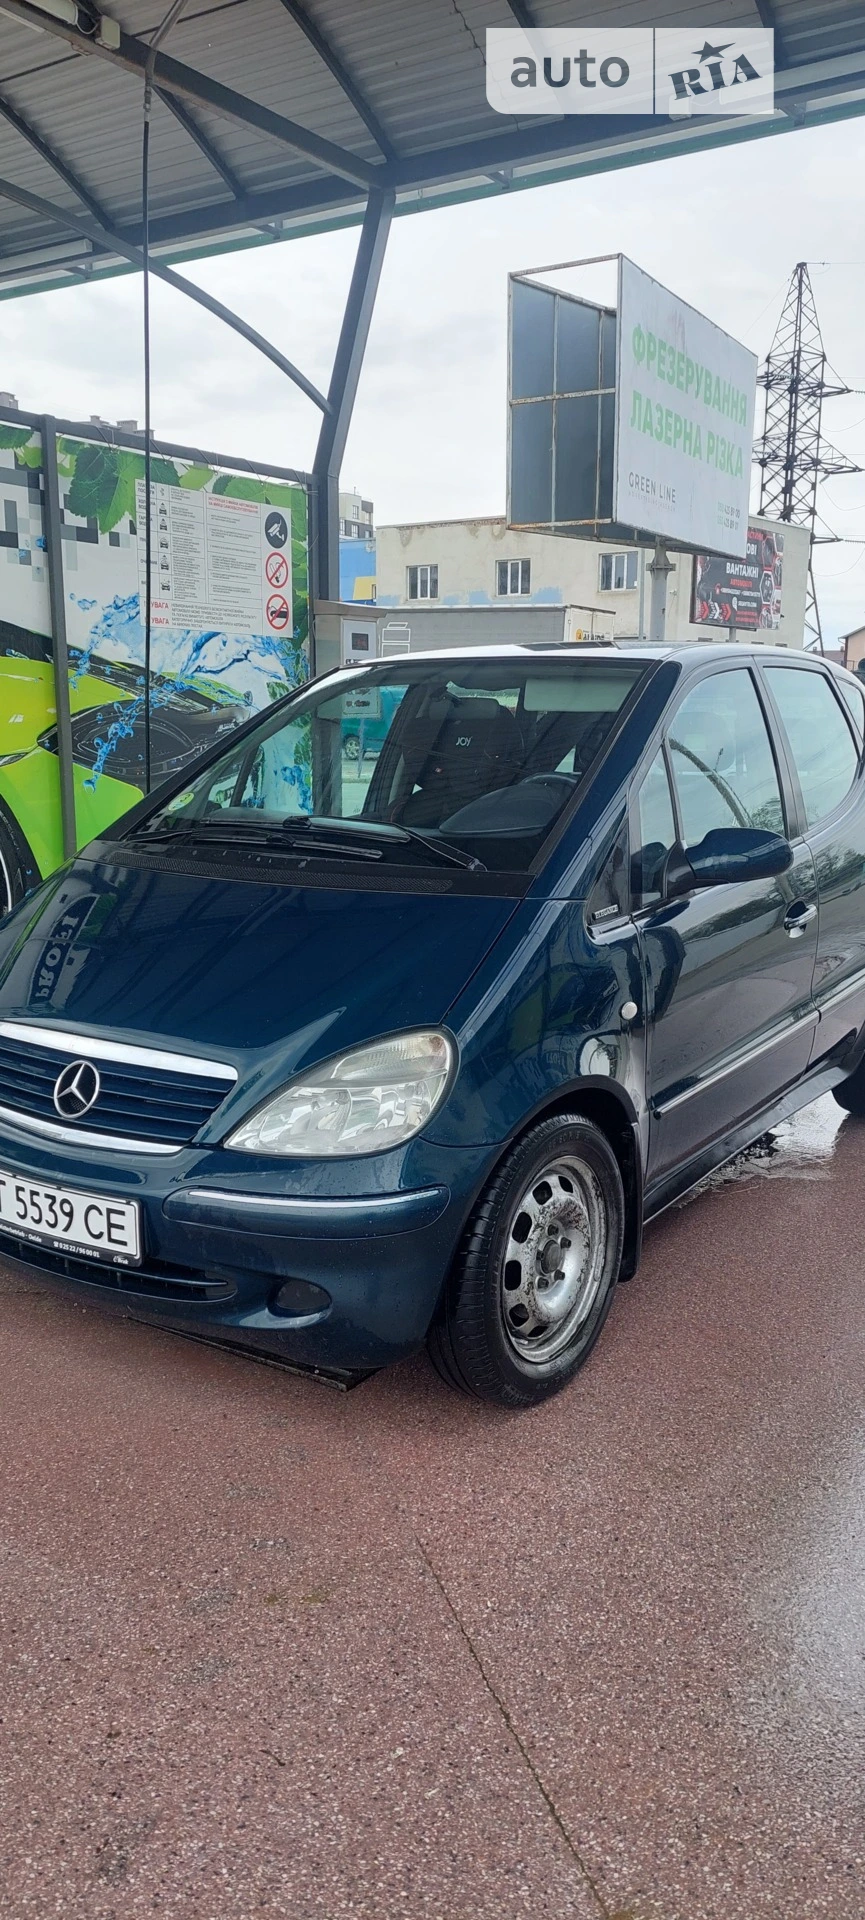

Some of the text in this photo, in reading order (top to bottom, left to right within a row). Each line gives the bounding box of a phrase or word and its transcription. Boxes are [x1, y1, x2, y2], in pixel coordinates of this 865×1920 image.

[632, 323, 747, 427] ФРЕЗЕРУВАННЯ
[630, 389, 744, 479] ЛАЗЕРНА РІЗКА
[629, 471, 676, 504] GREEN LINE
[726, 562, 759, 578] ВАНТАЖНІ
[150, 601, 169, 609] УВАГА
[151, 617, 170, 625] УВАГА
[456, 737, 472, 746] JOY
[15, 1185, 74, 1233] 5539
[84, 1204, 128, 1247] CE
